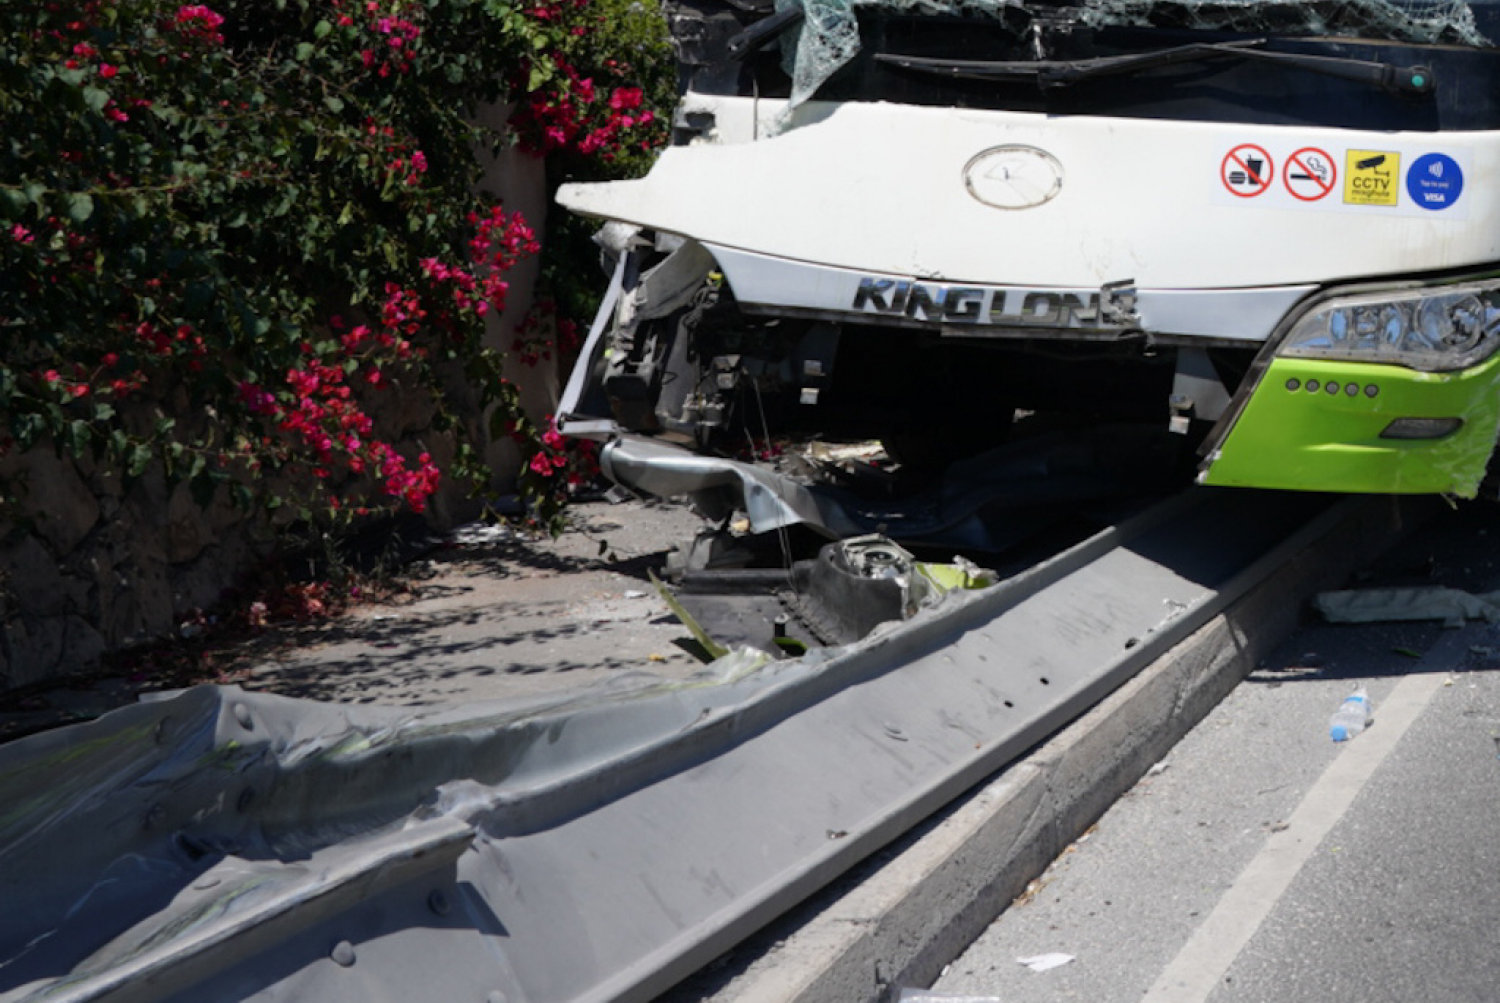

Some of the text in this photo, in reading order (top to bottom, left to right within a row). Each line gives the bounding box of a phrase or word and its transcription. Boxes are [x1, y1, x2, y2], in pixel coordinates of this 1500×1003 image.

[1352, 176, 1390, 189] CCTV
[1424, 192, 1445, 202] VISA
[853, 277, 984, 324] KING
